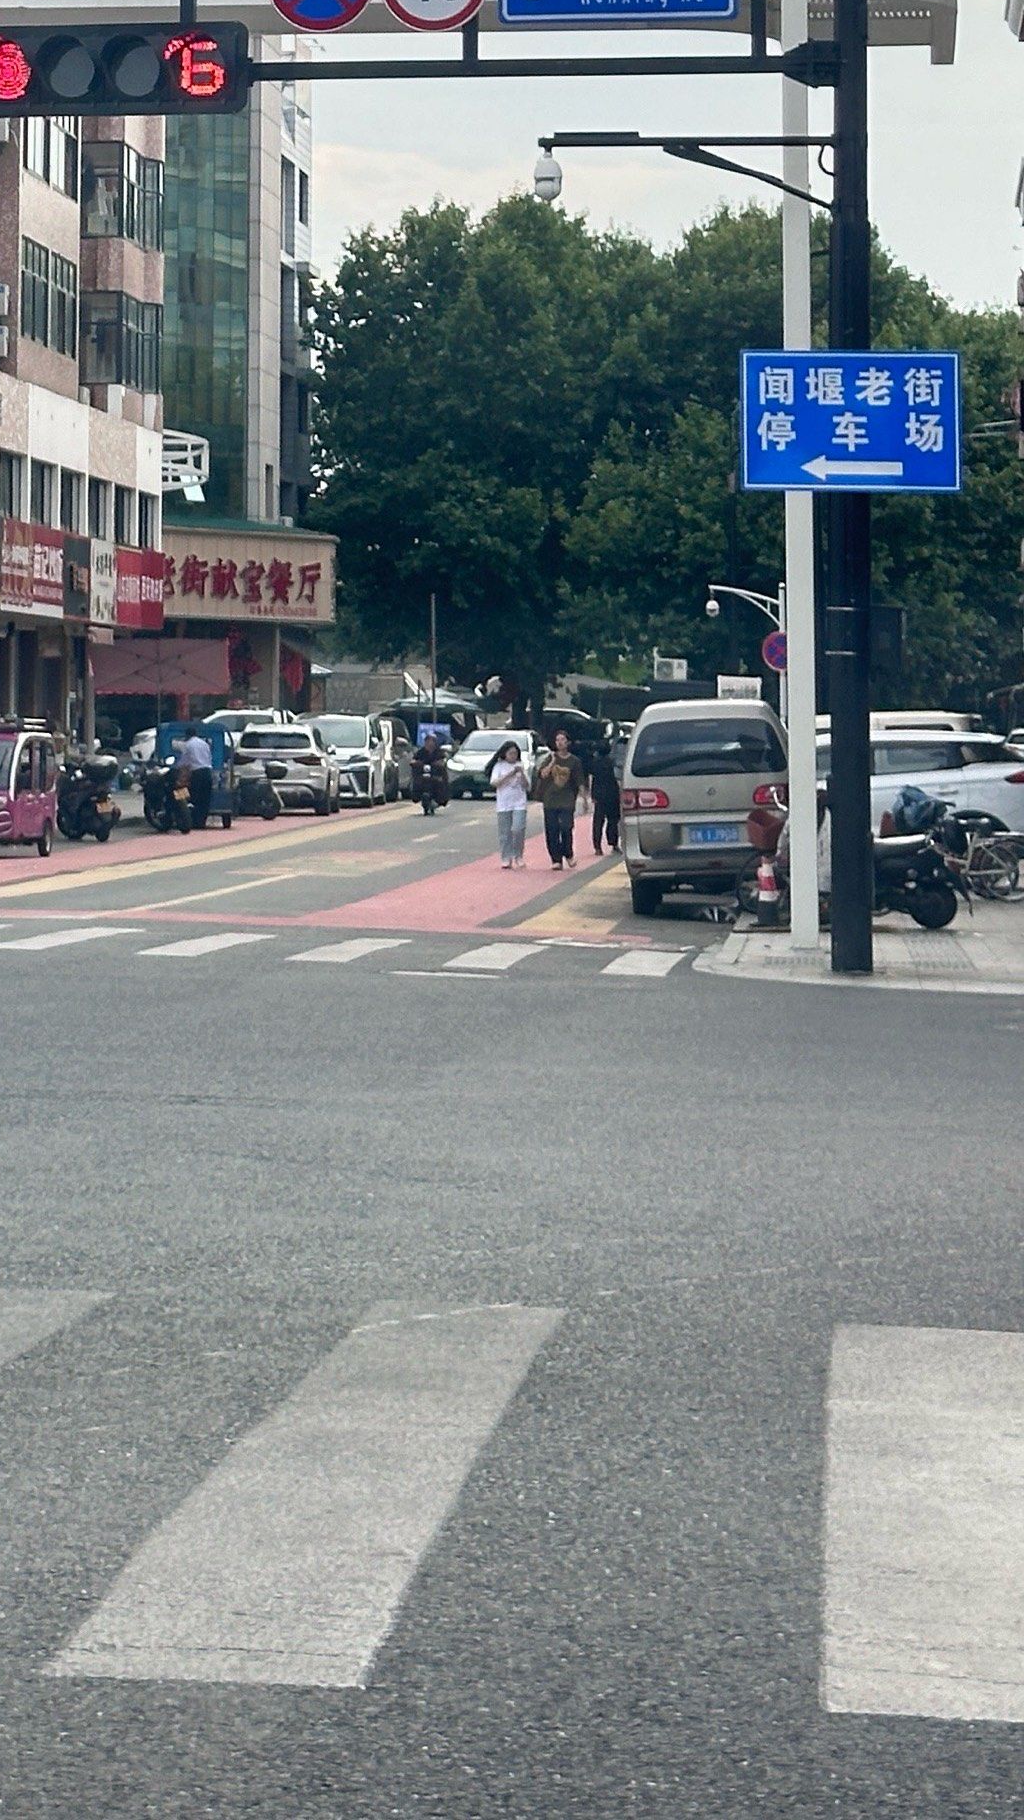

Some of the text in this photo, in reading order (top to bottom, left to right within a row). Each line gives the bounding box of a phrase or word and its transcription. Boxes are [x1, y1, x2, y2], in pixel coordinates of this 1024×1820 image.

[758, 366, 943, 407] 闻堰老街
[757, 411, 944, 453] 停车场
